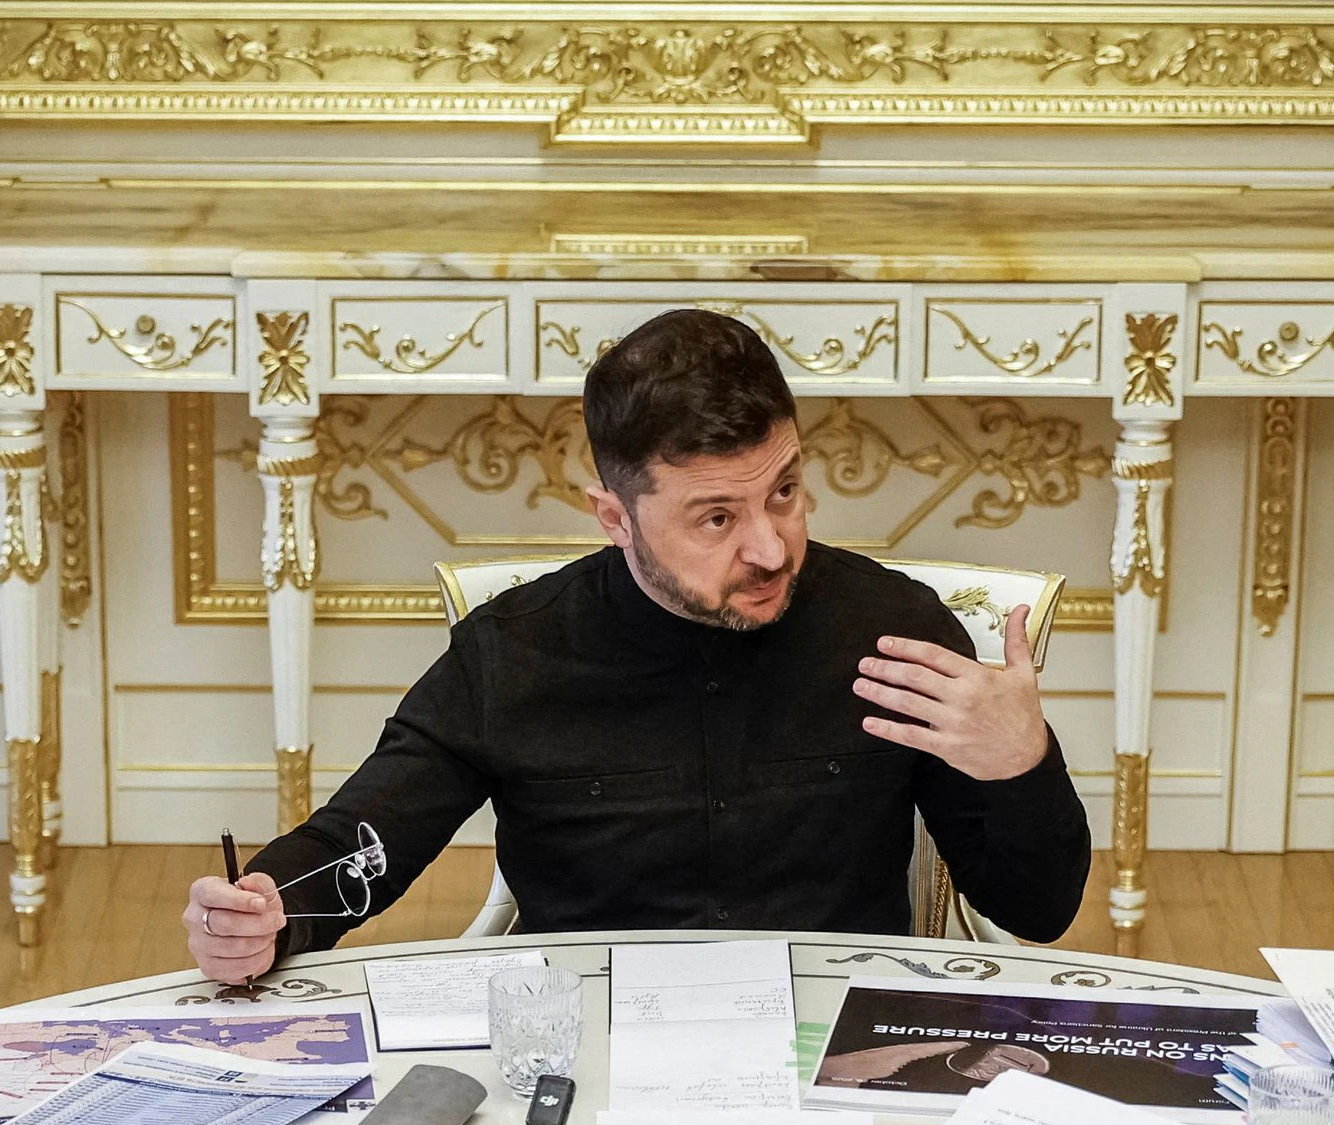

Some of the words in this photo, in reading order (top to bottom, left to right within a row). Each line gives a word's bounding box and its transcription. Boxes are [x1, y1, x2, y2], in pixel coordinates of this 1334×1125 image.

[873, 1024, 1008, 1040] PRESSURE
[1014, 1032, 1093, 1044] MORE
[1098, 1036, 1152, 1048] PUT
[1044, 1044, 1138, 1056] RUSSIA
[1158, 1040, 1194, 1051] TO
[1199, 1043, 1229, 1053] AS
[1146, 1050, 1186, 1060] ON
[1193, 1052, 1228, 1062] NS
